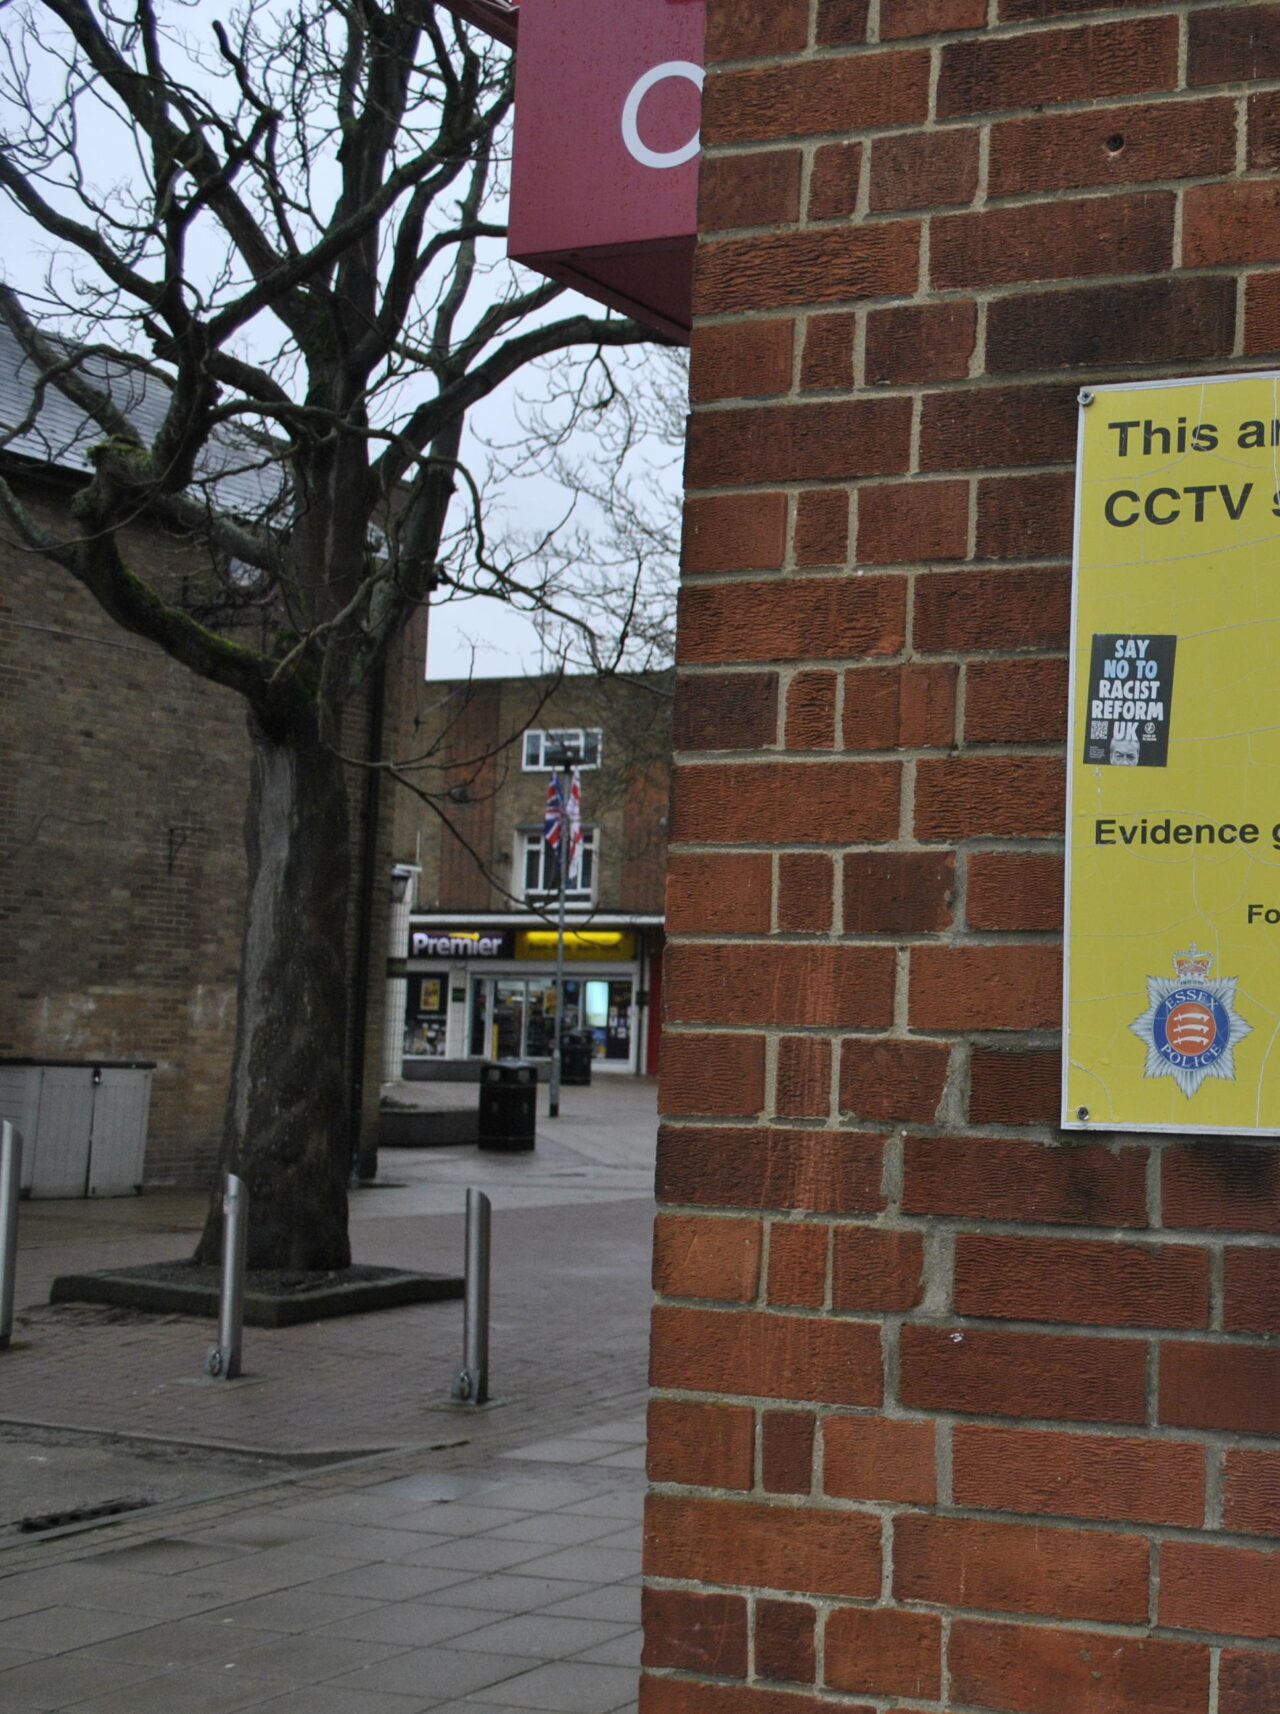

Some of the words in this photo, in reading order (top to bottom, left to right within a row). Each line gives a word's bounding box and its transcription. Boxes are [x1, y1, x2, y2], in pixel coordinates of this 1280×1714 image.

[1108, 417, 1219, 457] This
[1104, 482, 1254, 528] CCTV
[1115, 639, 1150, 658] SAY
[1104, 660, 1129, 679] NO
[1136, 660, 1158, 679] TO
[1099, 679, 1160, 699] RACIST
[1091, 700, 1164, 721] REFORM
[1113, 721, 1139, 741] UK
[1095, 818, 1260, 845] Evidence
[412, 932, 503, 956] Premier
[1165, 989, 1219, 1011] ESSEX
[1161, 1043, 1222, 1067] POLICE
